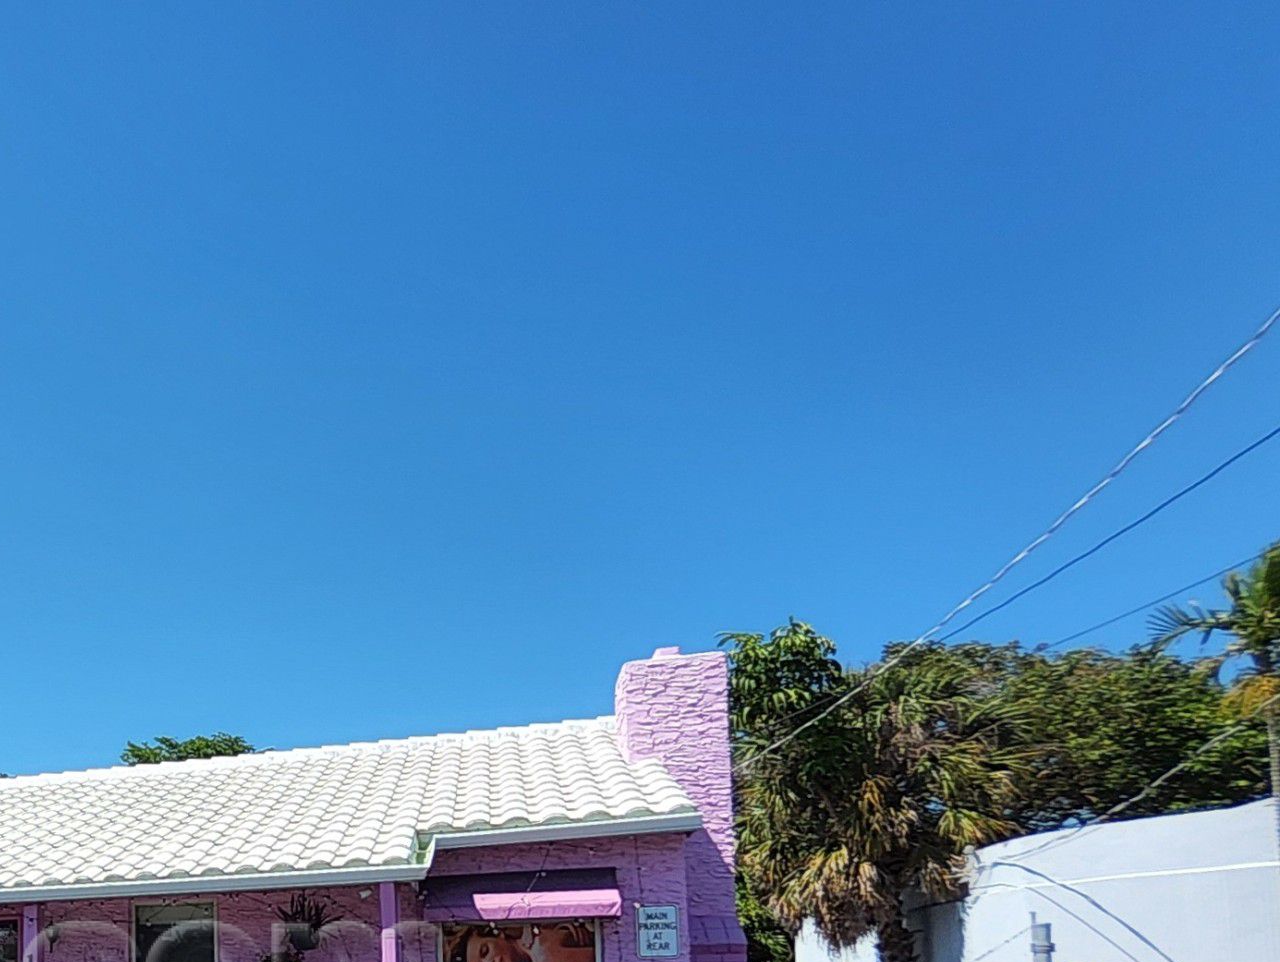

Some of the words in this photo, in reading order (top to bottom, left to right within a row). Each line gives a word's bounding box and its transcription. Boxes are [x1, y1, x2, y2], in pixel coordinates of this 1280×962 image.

[646, 912, 668, 920] MAIN
[640, 922, 677, 930] PARKING
[652, 932, 663, 940] AT
[646, 942, 670, 950] REAR
